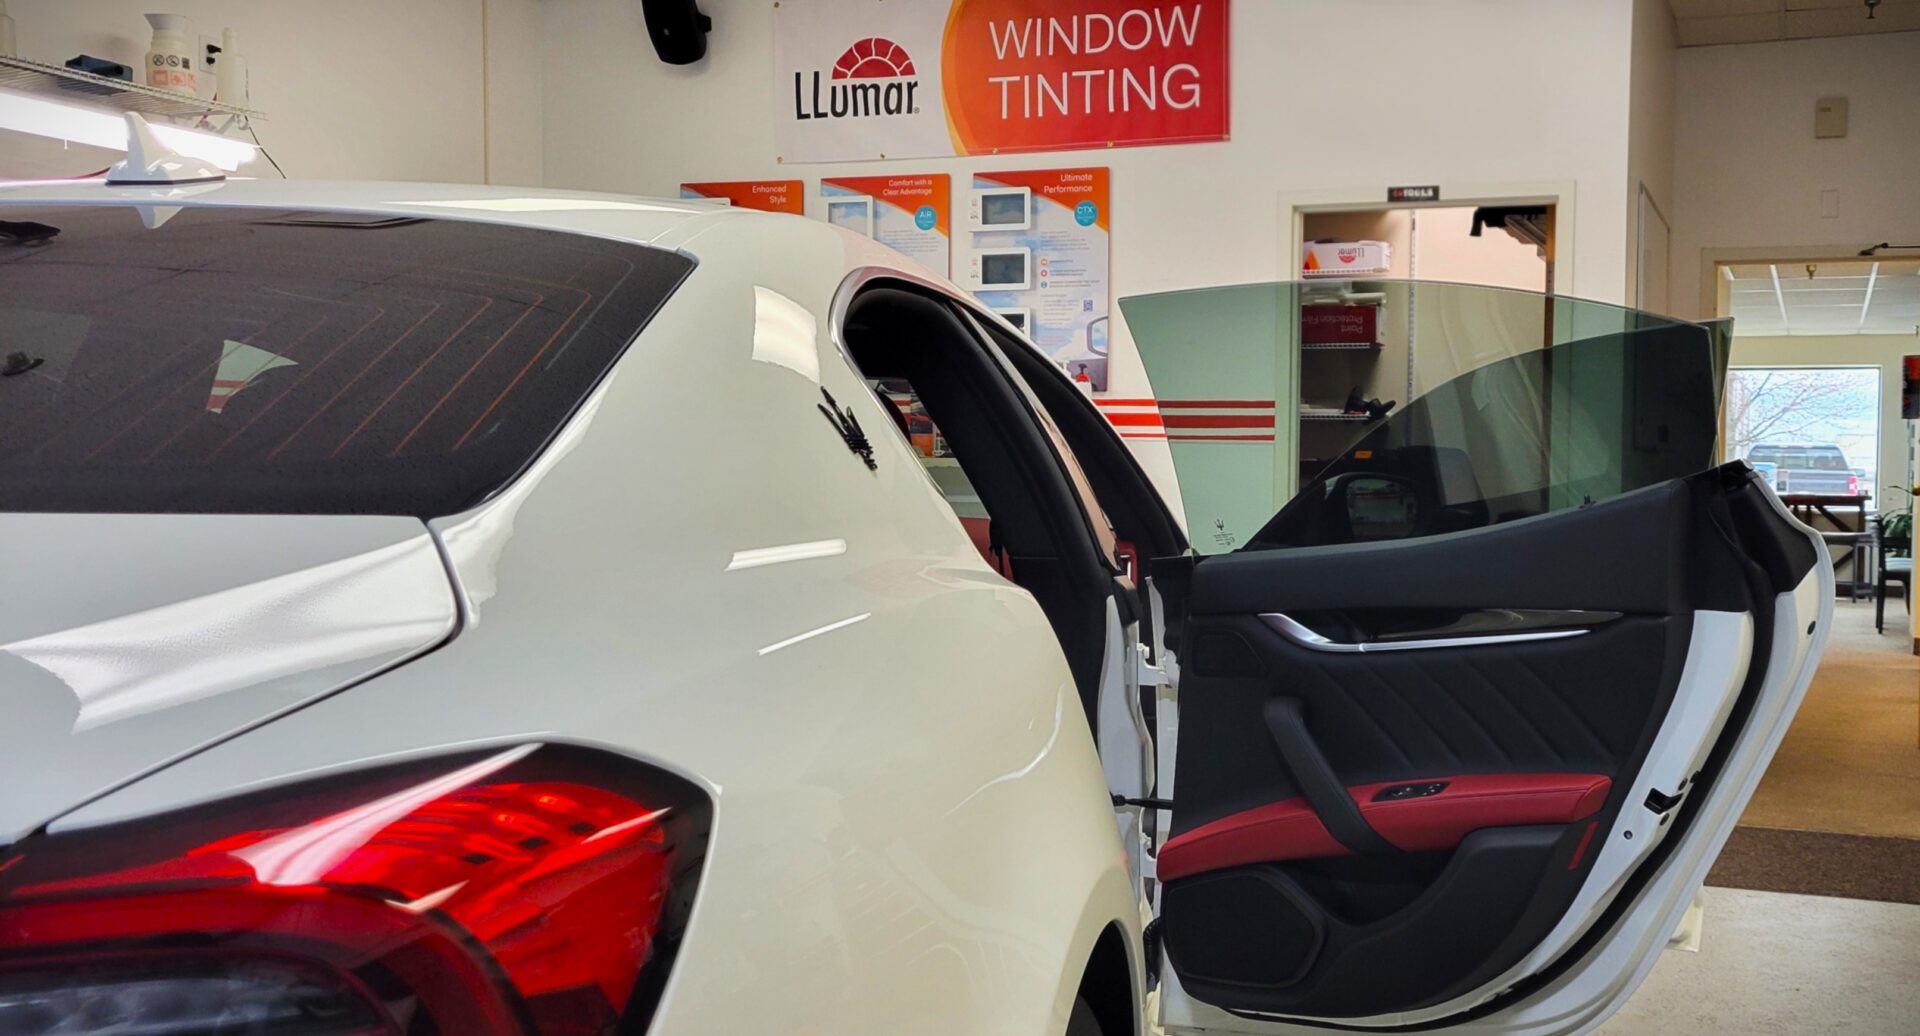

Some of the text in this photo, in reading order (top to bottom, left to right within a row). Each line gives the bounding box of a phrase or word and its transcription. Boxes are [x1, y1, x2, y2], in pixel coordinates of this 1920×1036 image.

[988, 4, 1202, 60] WINDOW
[795, 71, 918, 120] LLumar
[988, 63, 1201, 119] TINTING
[1060, 173, 1093, 182] Ultimate
[888, 179, 914, 187] Comfort
[752, 185, 787, 194] Enhanced
[882, 187, 933, 197] Clear Advantage
[1043, 185, 1093, 194] Performance
[769, 195, 787, 206] Style
[1319, 314, 1364, 325] Protection
[1341, 324, 1364, 334] Paint
